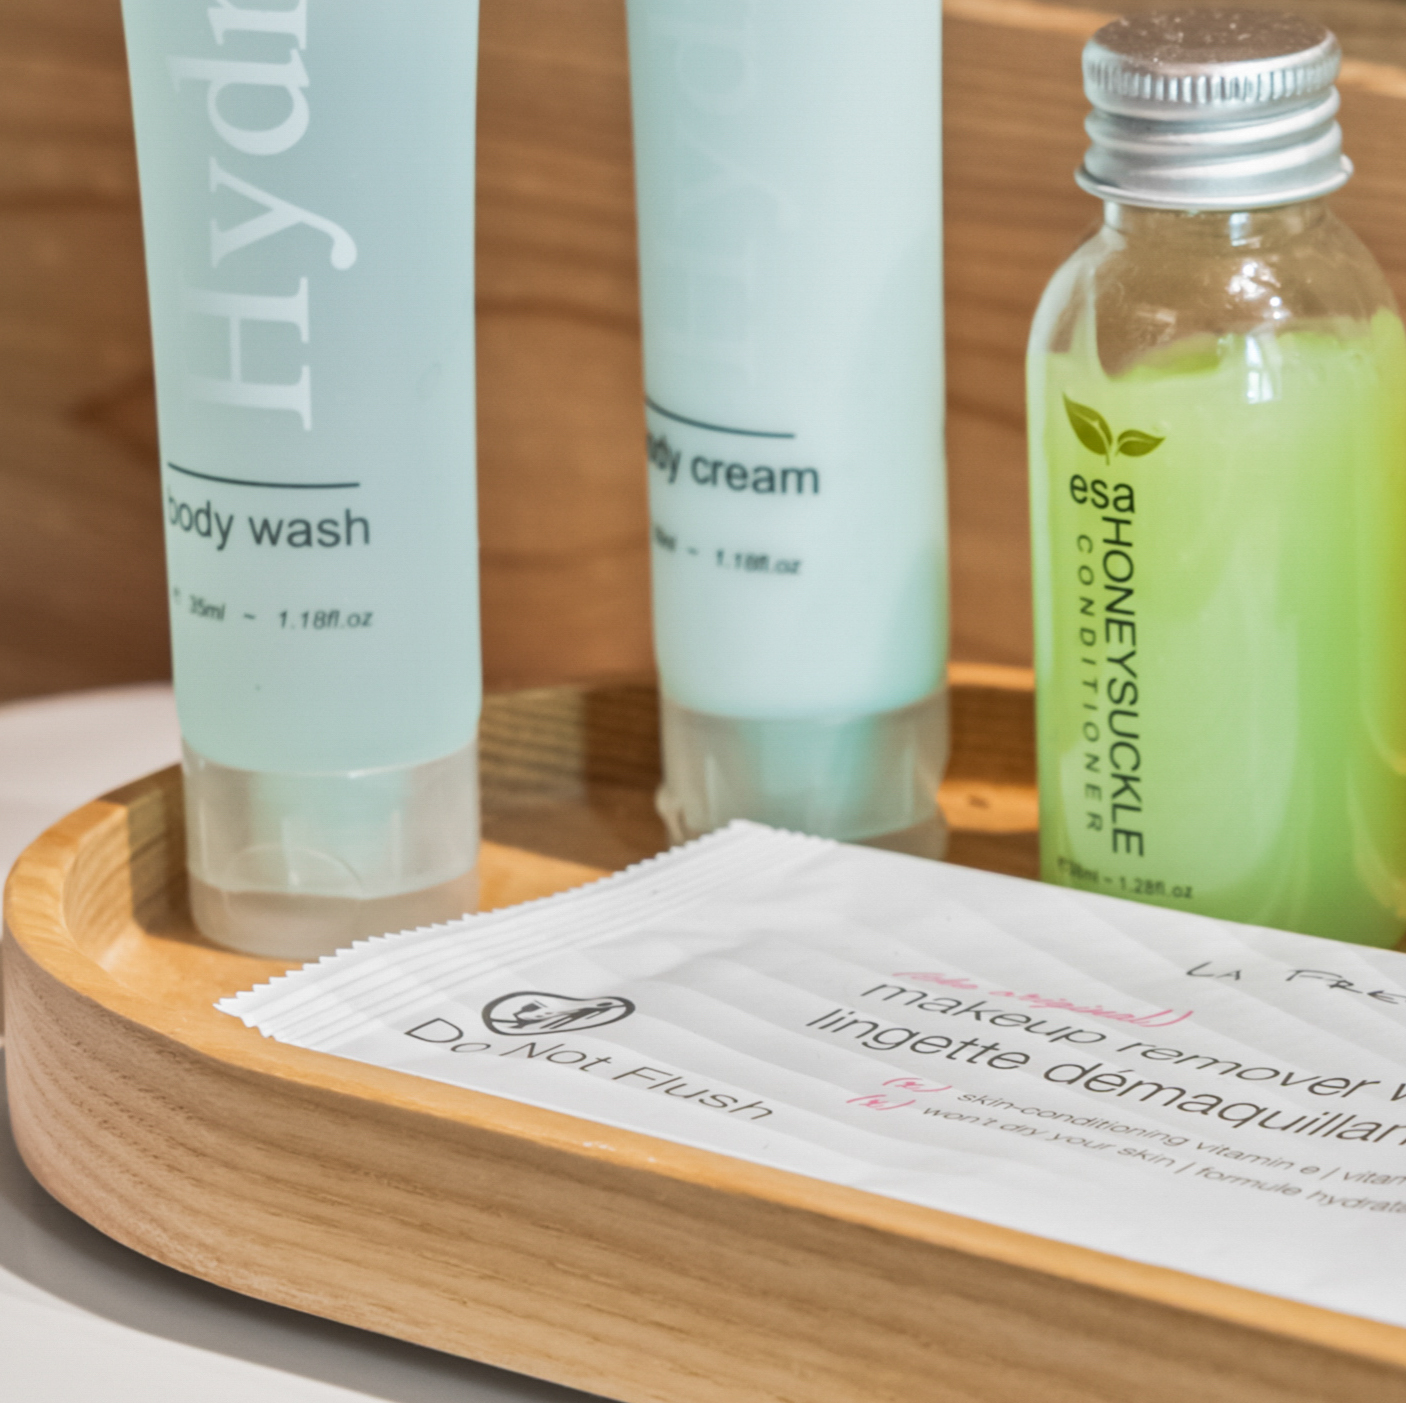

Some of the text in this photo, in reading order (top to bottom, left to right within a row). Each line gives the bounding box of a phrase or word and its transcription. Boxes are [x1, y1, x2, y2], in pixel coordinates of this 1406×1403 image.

[690, 455, 820, 494] cream
[1070, 474, 1135, 513] esa
[248, 508, 370, 548] wash
[1077, 534, 1103, 832] CONDITIONER
[1102, 516, 1145, 857] HONEYSUCKLE
[1185, 961, 1242, 981] LA
[404, 1017, 773, 1120] Do Not Flush
[806, 1008, 1031, 1070] lingette
[860, 983, 1107, 1044] makeup
[1116, 1041, 1381, 1098] remover
[957, 1093, 1189, 1147] skin-conditioning
[1196, 1140, 1295, 1170] vitamin
[998, 1120, 1050, 1138] dry
[1045, 1132, 1117, 1151] your
[1117, 1144, 1176, 1167] skin
[1195, 1165, 1302, 1196] formule
